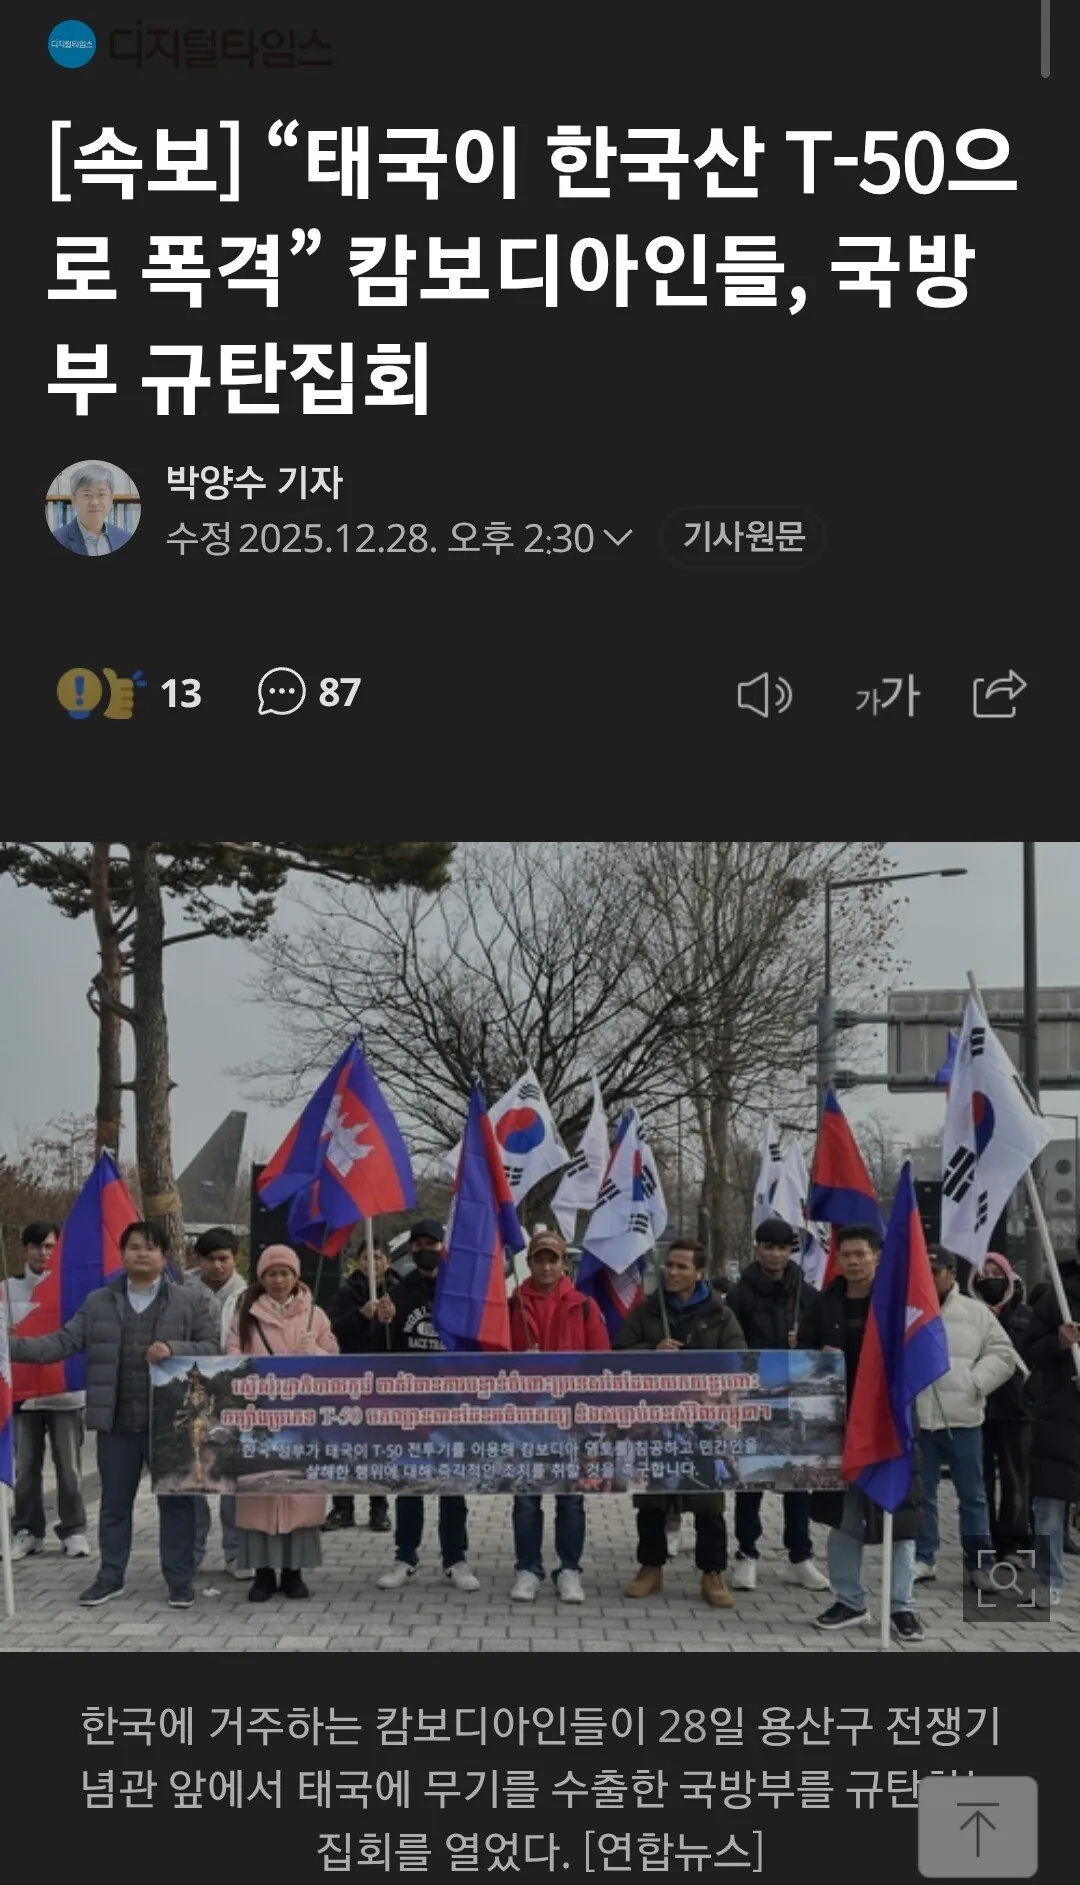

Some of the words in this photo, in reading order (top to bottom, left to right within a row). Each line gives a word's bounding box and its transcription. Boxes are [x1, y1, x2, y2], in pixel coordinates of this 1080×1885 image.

[108, 20, 333, 70] 디지털타임스
[48, 120, 241, 202] [속보]
[266, 119, 517, 200] “태국이
[546, 123, 765, 200] 한국산
[785, 125, 1019, 196] T-50으
[46, 236, 118, 300] 로
[141, 228, 323, 308] 폭격”
[348, 232, 807, 316] 캄보디아인들,
[830, 232, 976, 308] 국방
[46, 342, 118, 417] 부
[141, 340, 429, 416] 규탄집회
[166, 465, 267, 501] 박양수
[277, 465, 344, 501] 기자
[166, 521, 230, 557] 수정
[239, 523, 437, 554] 2025.12.28.
[447, 521, 515, 556] 오후
[524, 523, 594, 556] 2:30
[683, 520, 806, 553] 기사원문
[160, 678, 202, 708] 13
[318, 677, 362, 707] 87
[319, 1405, 363, 1427] T-50
[325, 1441, 369, 1460] 태국이
[373, 1442, 403, 1460] T-50
[408, 1441, 465, 1459] 전투기를
[471, 1441, 515, 1459] 이용해
[521, 1441, 578, 1460] 캄보디아
[634, 1439, 693, 1457] 침공하고
[699, 1437, 757, 1457] 민간인을
[306, 1463, 350, 1481] 살해한
[355, 1463, 399, 1481] 행위에
[403, 1463, 433, 1480] 대해
[438, 1463, 496, 1480] 즉각적인
[500, 1462, 545, 1482] 조치를
[551, 1462, 581, 1480] 취할
[587, 1461, 615, 1478] 것을
[81, 1706, 193, 1747] 한국에
[209, 1706, 362, 1746] 거주하는
[376, 1706, 644, 1746] 캄보디아인들이
[658, 1706, 744, 1746] 28일
[757, 1706, 874, 1747] 용산구
[886, 1706, 998, 1747] 전쟁기
[82, 1769, 158, 1809] 념관
[169, 1769, 282, 1809] 앞에서
[299, 1769, 410, 1810] 태국에
[423, 1769, 540, 1809] 무기를
[551, 1769, 669, 1809] 수출한
[679, 1769, 834, 1810] 국방부를
[845, 1769, 978, 1809] 규탄
[317, 1832, 432, 1872] 집회를
[445, 1832, 570, 1872] 열었다.
[585, 1829, 764, 1873] [연합뉴스]
